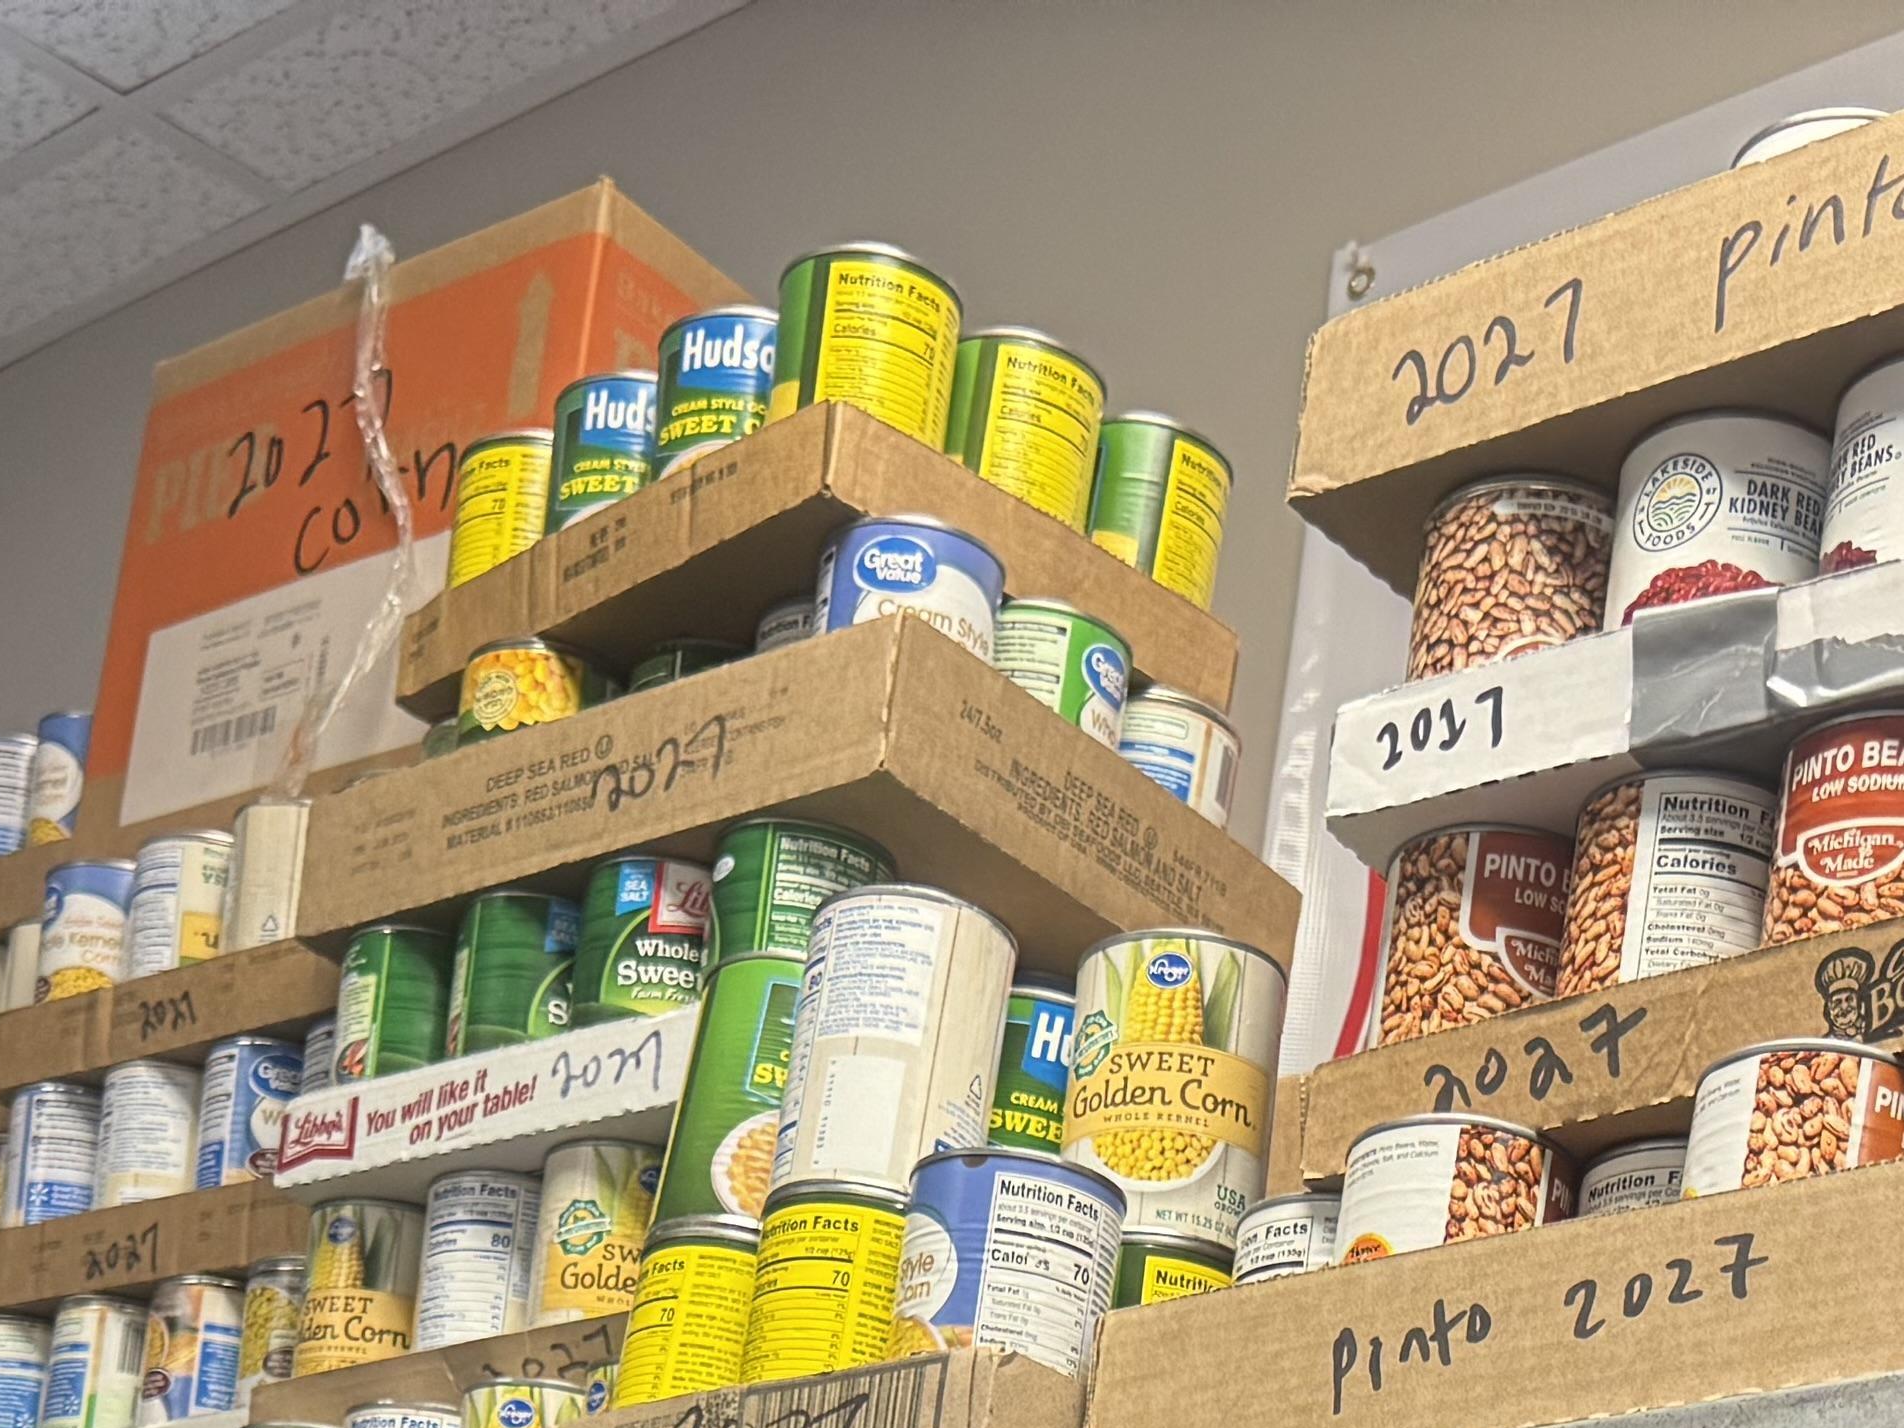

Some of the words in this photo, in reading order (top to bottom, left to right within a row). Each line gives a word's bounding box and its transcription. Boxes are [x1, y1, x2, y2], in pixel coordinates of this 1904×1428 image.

[1392, 278, 1584, 426] 2027
[486, 767, 523, 793] DEEP
[528, 757, 556, 781] SEA
[559, 748, 590, 773] RED
[592, 714, 727, 812] 2027
[1792, 747, 1856, 792] PINTO
[551, 1030, 662, 1099] 2027
[1108, 1053, 1215, 1078] SWEET
[1424, 1004, 1647, 1112] 2027
[365, 1110, 395, 1138] You
[400, 1084, 432, 1126] will
[436, 1079, 471, 1112] like
[472, 1068, 489, 1096] it
[409, 1119, 432, 1145] on
[434, 1102, 477, 1142] your
[482, 1075, 538, 1120] table!
[1073, 1077, 1174, 1124] Golden
[1180, 1084, 1253, 1130] Corn
[1102, 1113, 1150, 1126] WHOLE
[1156, 1113, 1210, 1129] KERNEL
[999, 1177, 1069, 1213] Nutrition
[1070, 1197, 1100, 1221] Facts
[80, 1222, 160, 1282] 2027
[1071, 1263, 1091, 1287] 70
[1564, 1233, 1770, 1340] 2027
